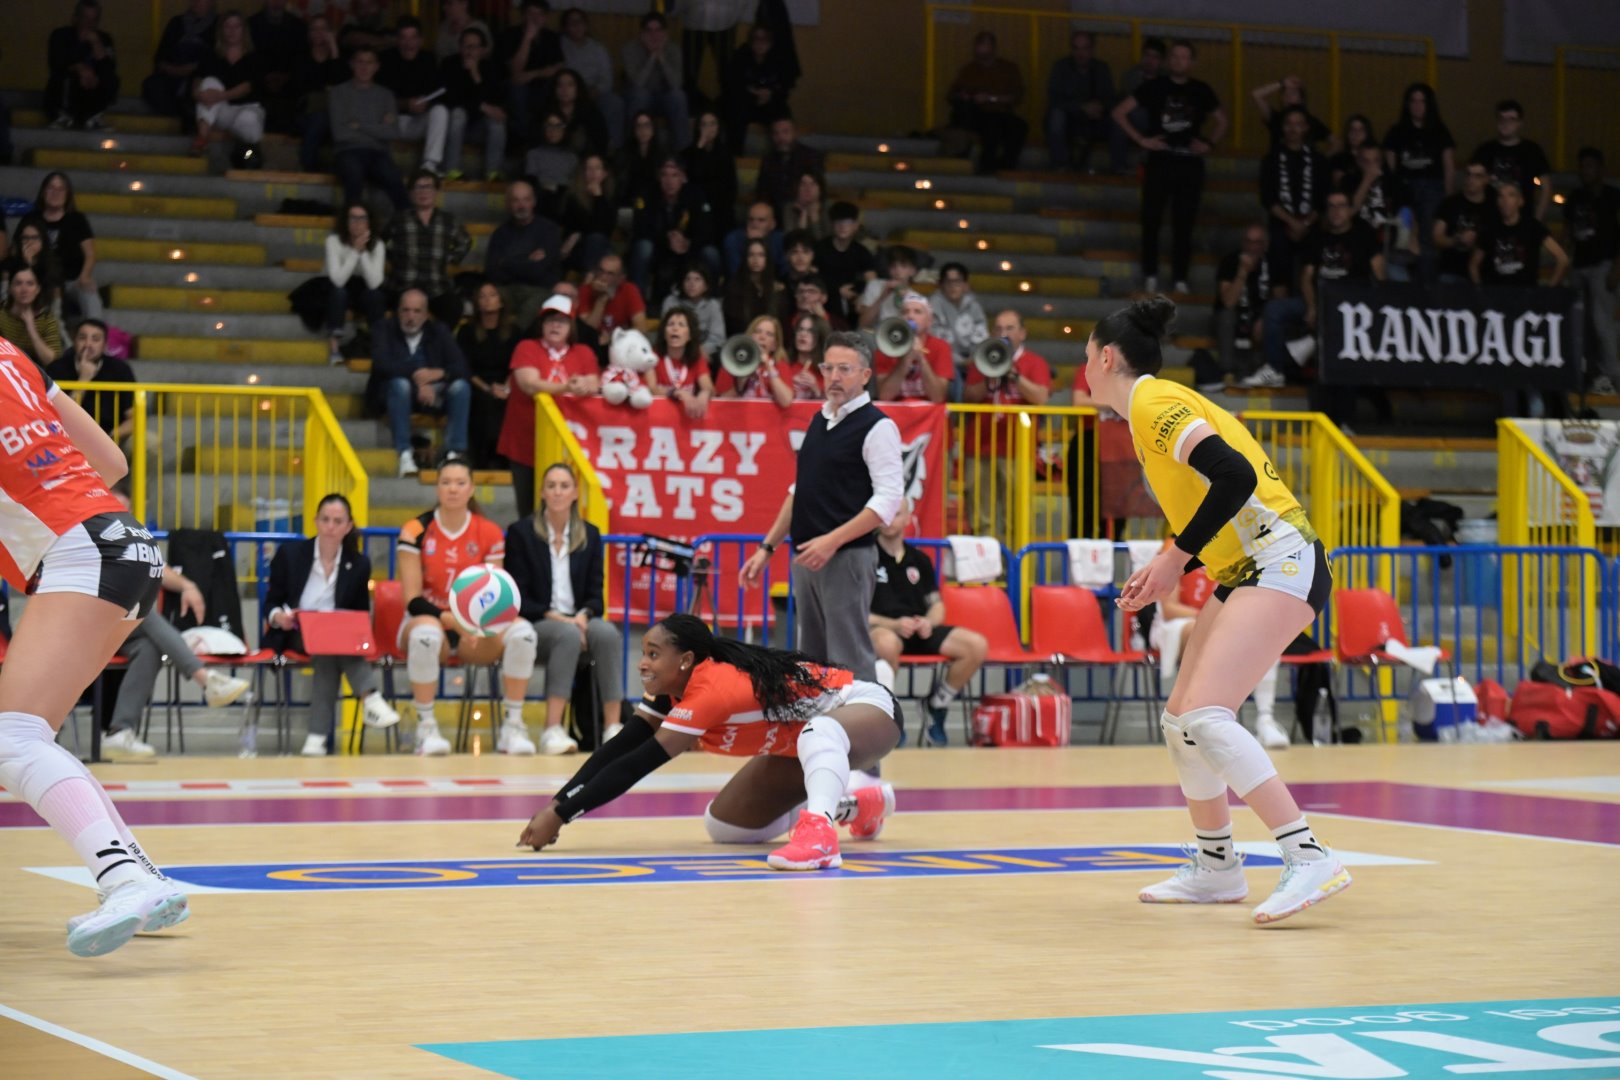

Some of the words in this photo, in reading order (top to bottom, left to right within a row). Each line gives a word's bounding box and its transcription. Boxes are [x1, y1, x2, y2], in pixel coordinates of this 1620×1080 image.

[1337, 301, 1565, 368] RANDAGI
[266, 850, 1192, 884] FINECO
[1228, 1010, 1470, 1032] good
[1484, 1006, 1620, 1021] eel
